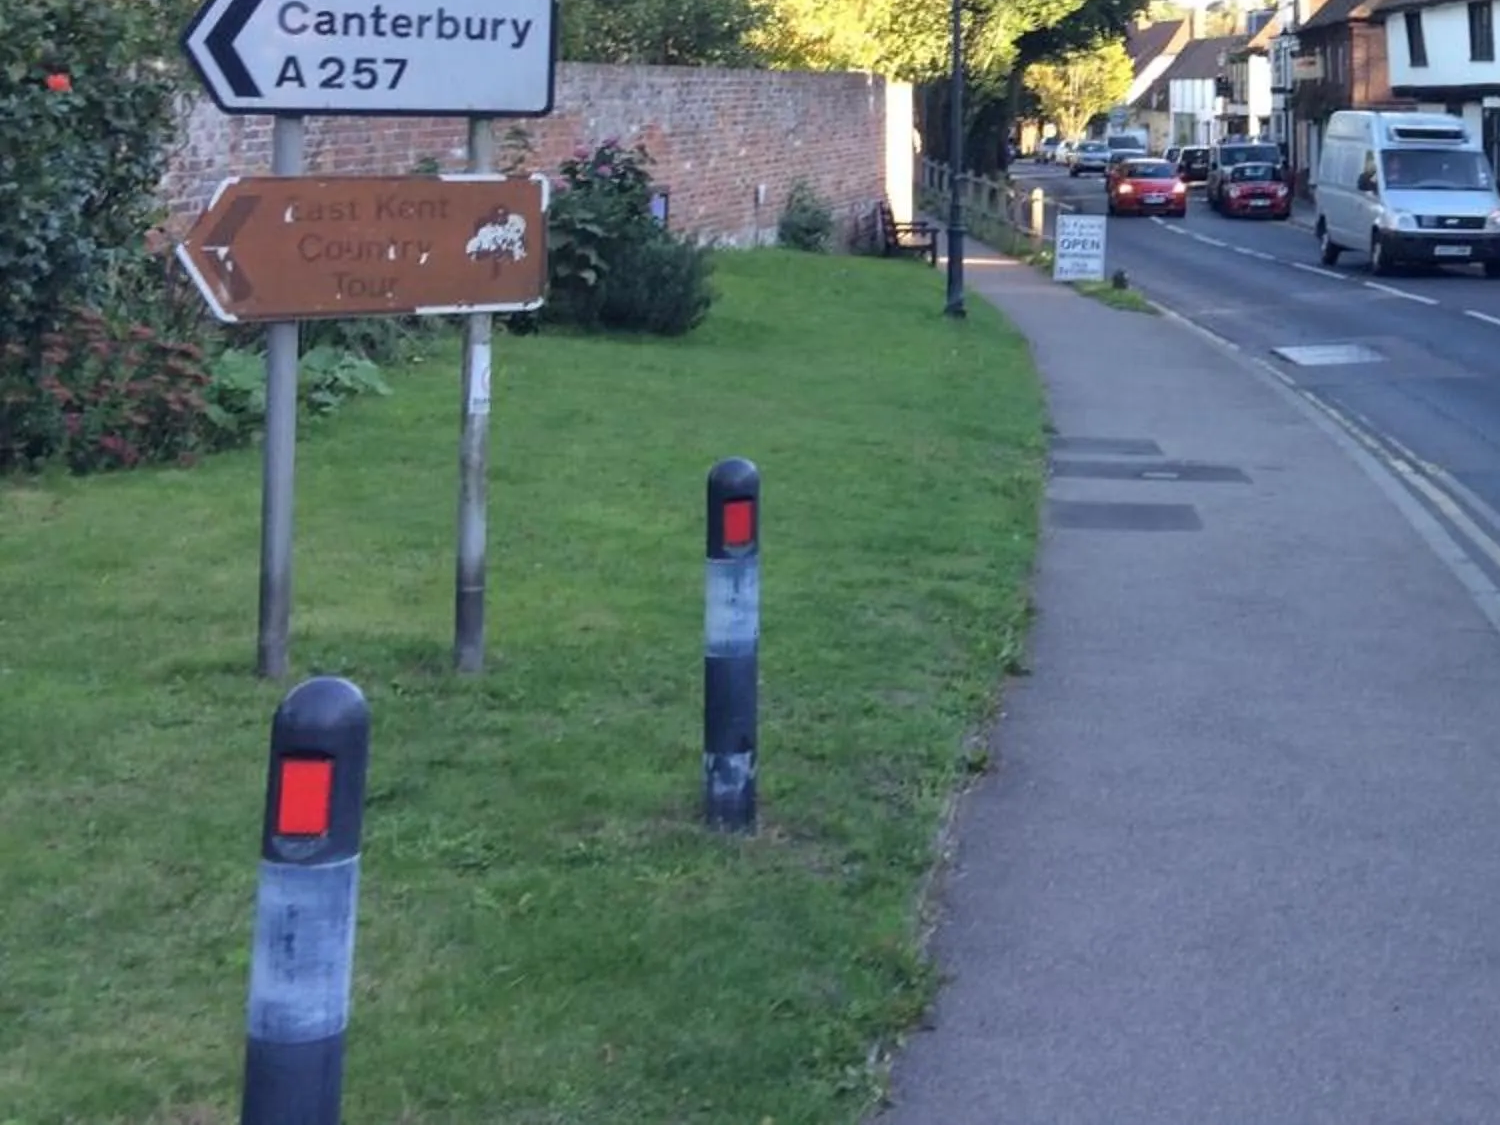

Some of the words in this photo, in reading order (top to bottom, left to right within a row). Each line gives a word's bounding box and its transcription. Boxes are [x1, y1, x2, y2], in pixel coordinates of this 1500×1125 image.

[277, 0, 533, 49] Canterbury
[374, 193, 451, 221] Kent
[297, 232, 435, 268] Country
[1061, 238, 1100, 251] OPEN
[331, 271, 400, 298] Tour
